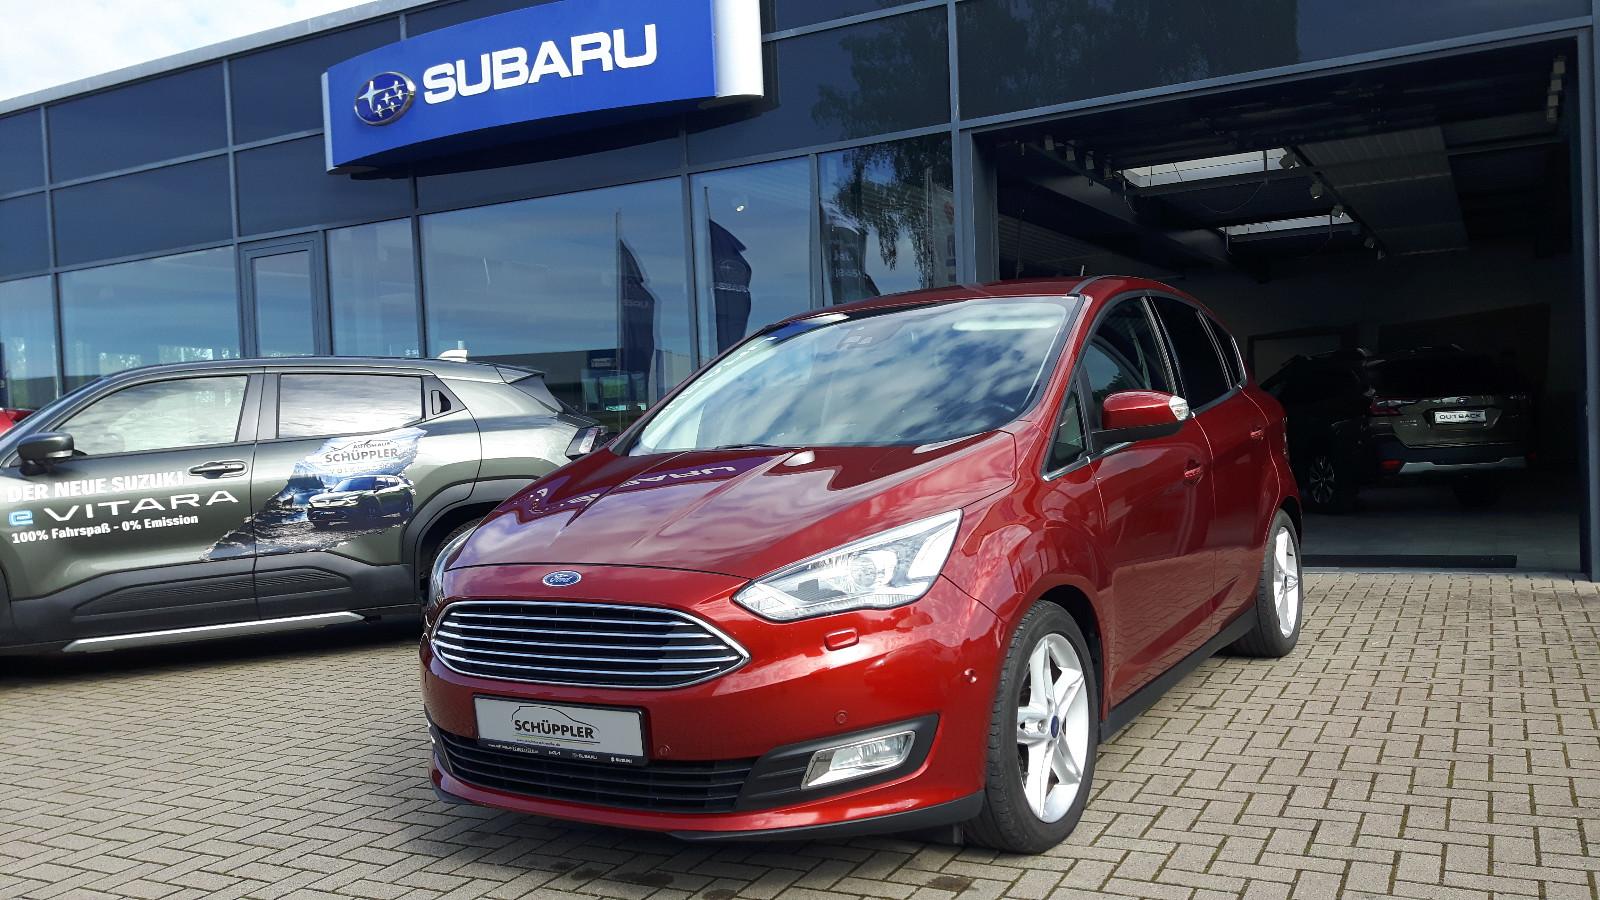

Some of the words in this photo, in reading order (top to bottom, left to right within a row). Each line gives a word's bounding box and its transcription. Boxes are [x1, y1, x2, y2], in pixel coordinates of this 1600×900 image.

[423, 23, 658, 105] SUBARU
[325, 448, 399, 463] SCHÜPPLER
[7, 483, 49, 502] DER
[54, 478, 107, 497] NEUE
[112, 471, 184, 492] SUZUKI
[43, 490, 239, 522] VITARA
[11, 530, 49, 544] 100%
[51, 523, 111, 540] Fahrspaß
[122, 520, 141, 532] 0%
[144, 514, 199, 529] Emission
[514, 720, 594, 739] SCHÜPPLER
